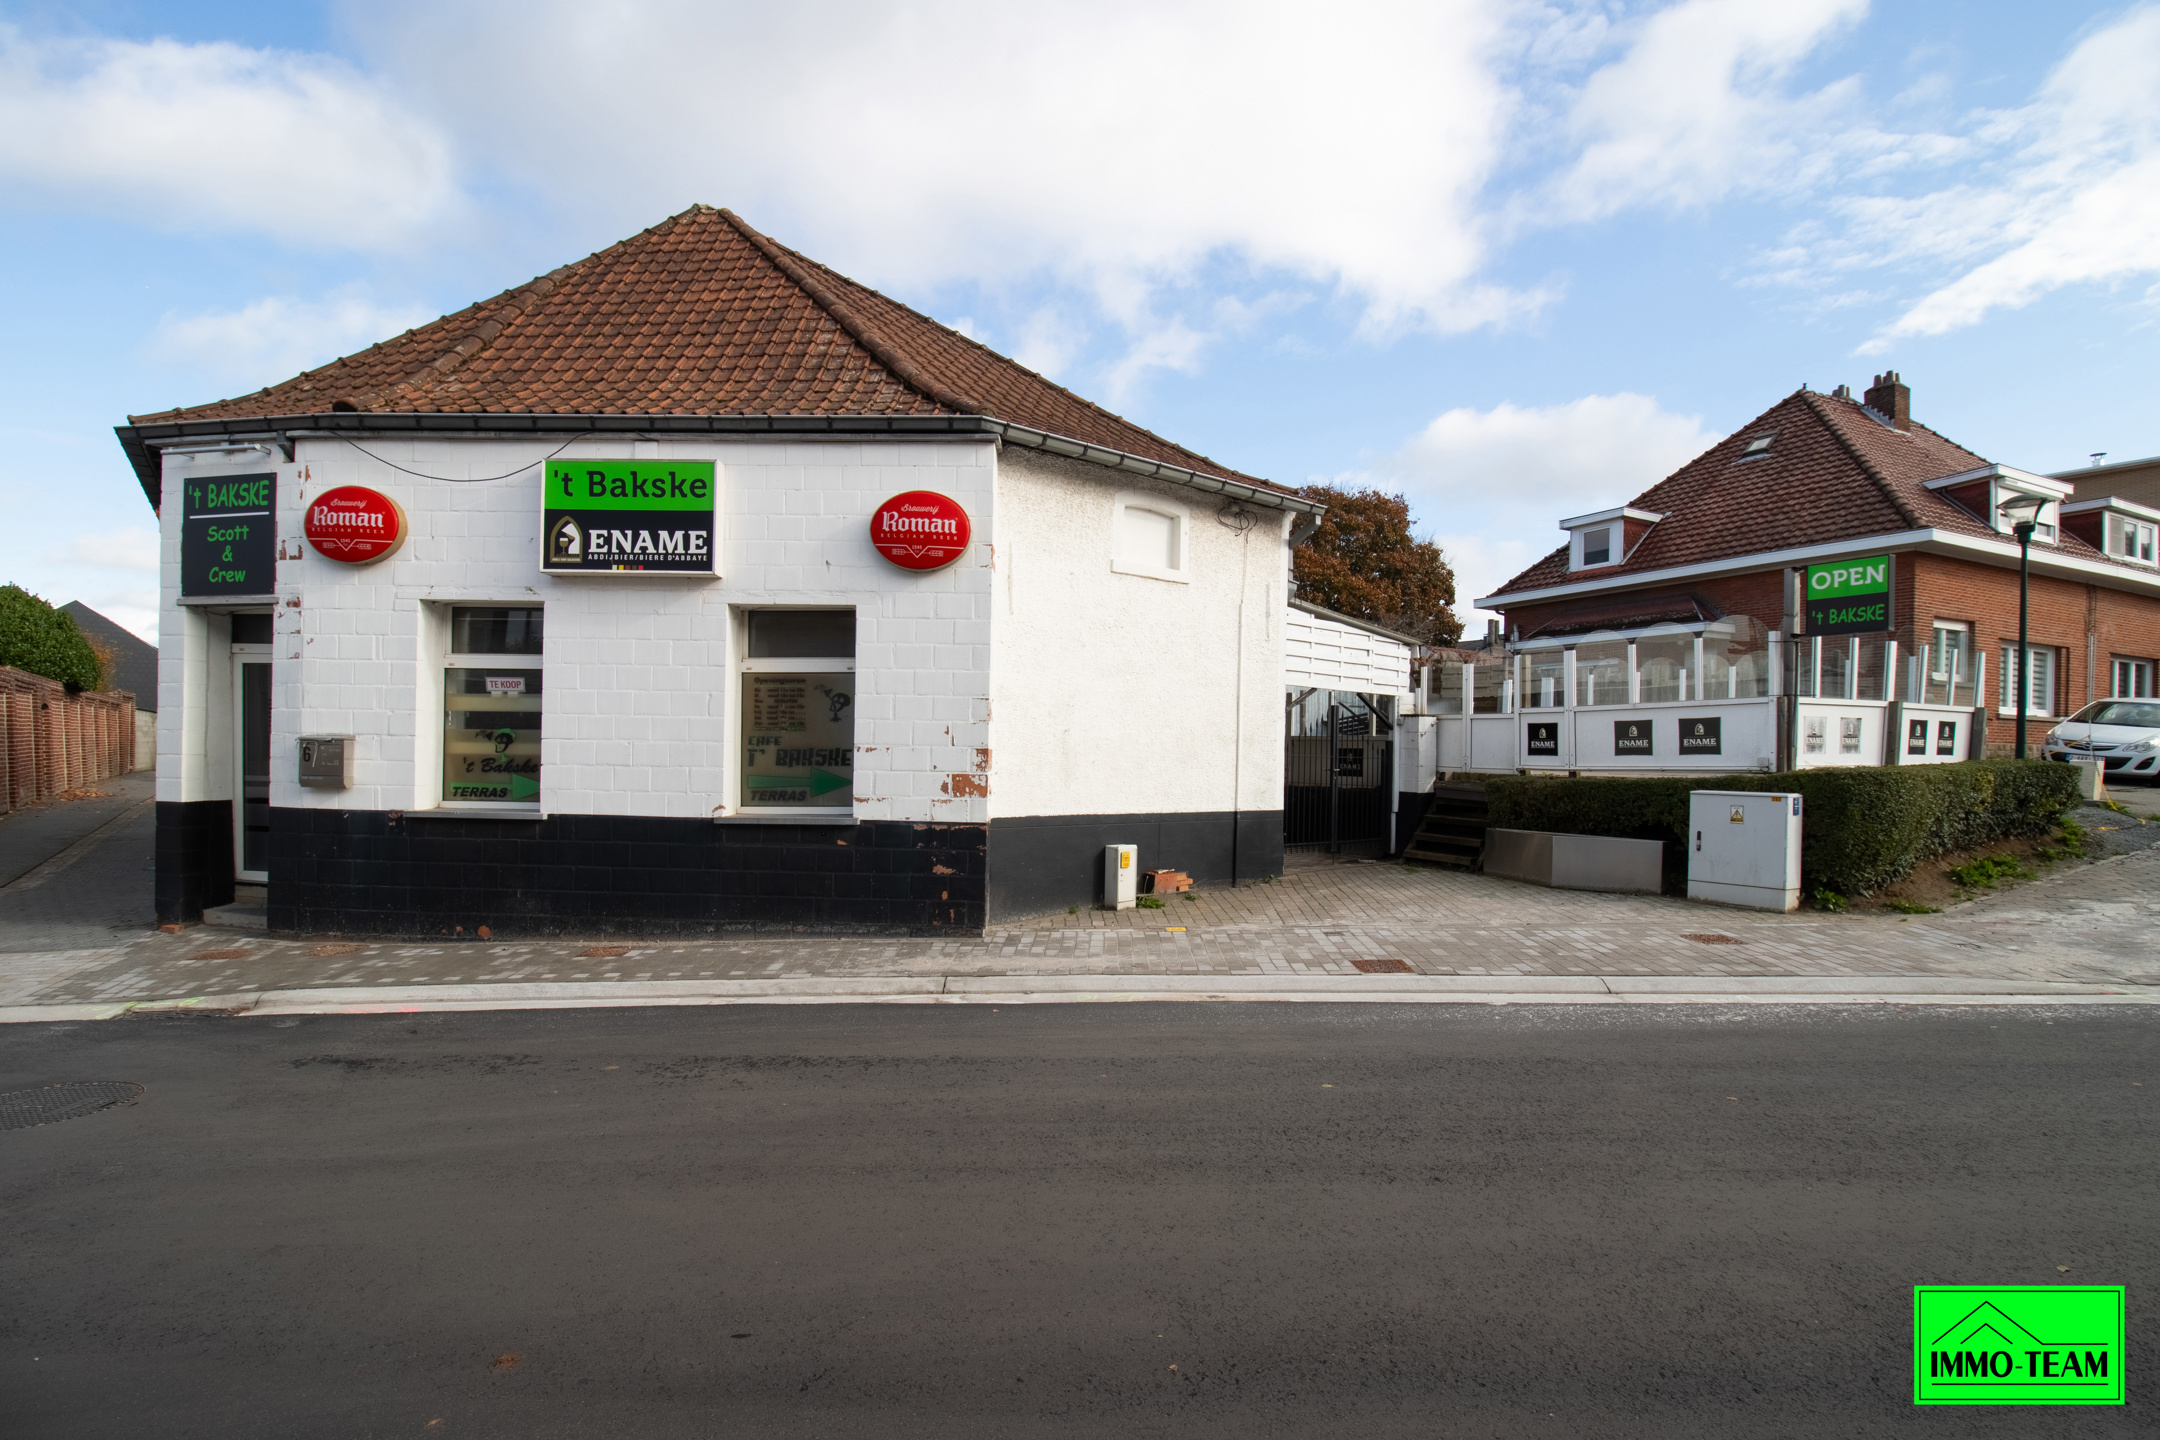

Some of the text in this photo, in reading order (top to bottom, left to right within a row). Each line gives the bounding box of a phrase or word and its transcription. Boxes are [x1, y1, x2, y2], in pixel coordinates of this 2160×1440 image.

[554, 469, 708, 499] 't Bakske
[189, 480, 270, 509] 't BAKSKE
[330, 498, 368, 509] Brouwerij
[901, 503, 939, 515] Brouwerij
[313, 505, 384, 528] Roman
[882, 511, 958, 534] Roman
[207, 525, 249, 542] Scott
[588, 529, 708, 554] ENAME
[222, 545, 233, 562] &
[667, 554, 708, 562] D'ABBAYE
[208, 566, 246, 582] Crew
[1811, 564, 1885, 590] OPEN
[1812, 603, 1885, 626] 't BAKSKE
[489, 680, 521, 689] TE KOOP
[1618, 739, 1649, 747] ENAME
[1683, 738, 1717, 746] ENAME
[480, 757, 540, 774] Bakske
[775, 747, 853, 768] BAKSKE
[452, 786, 508, 798] TERRAS
[750, 790, 807, 801] TERRAS
